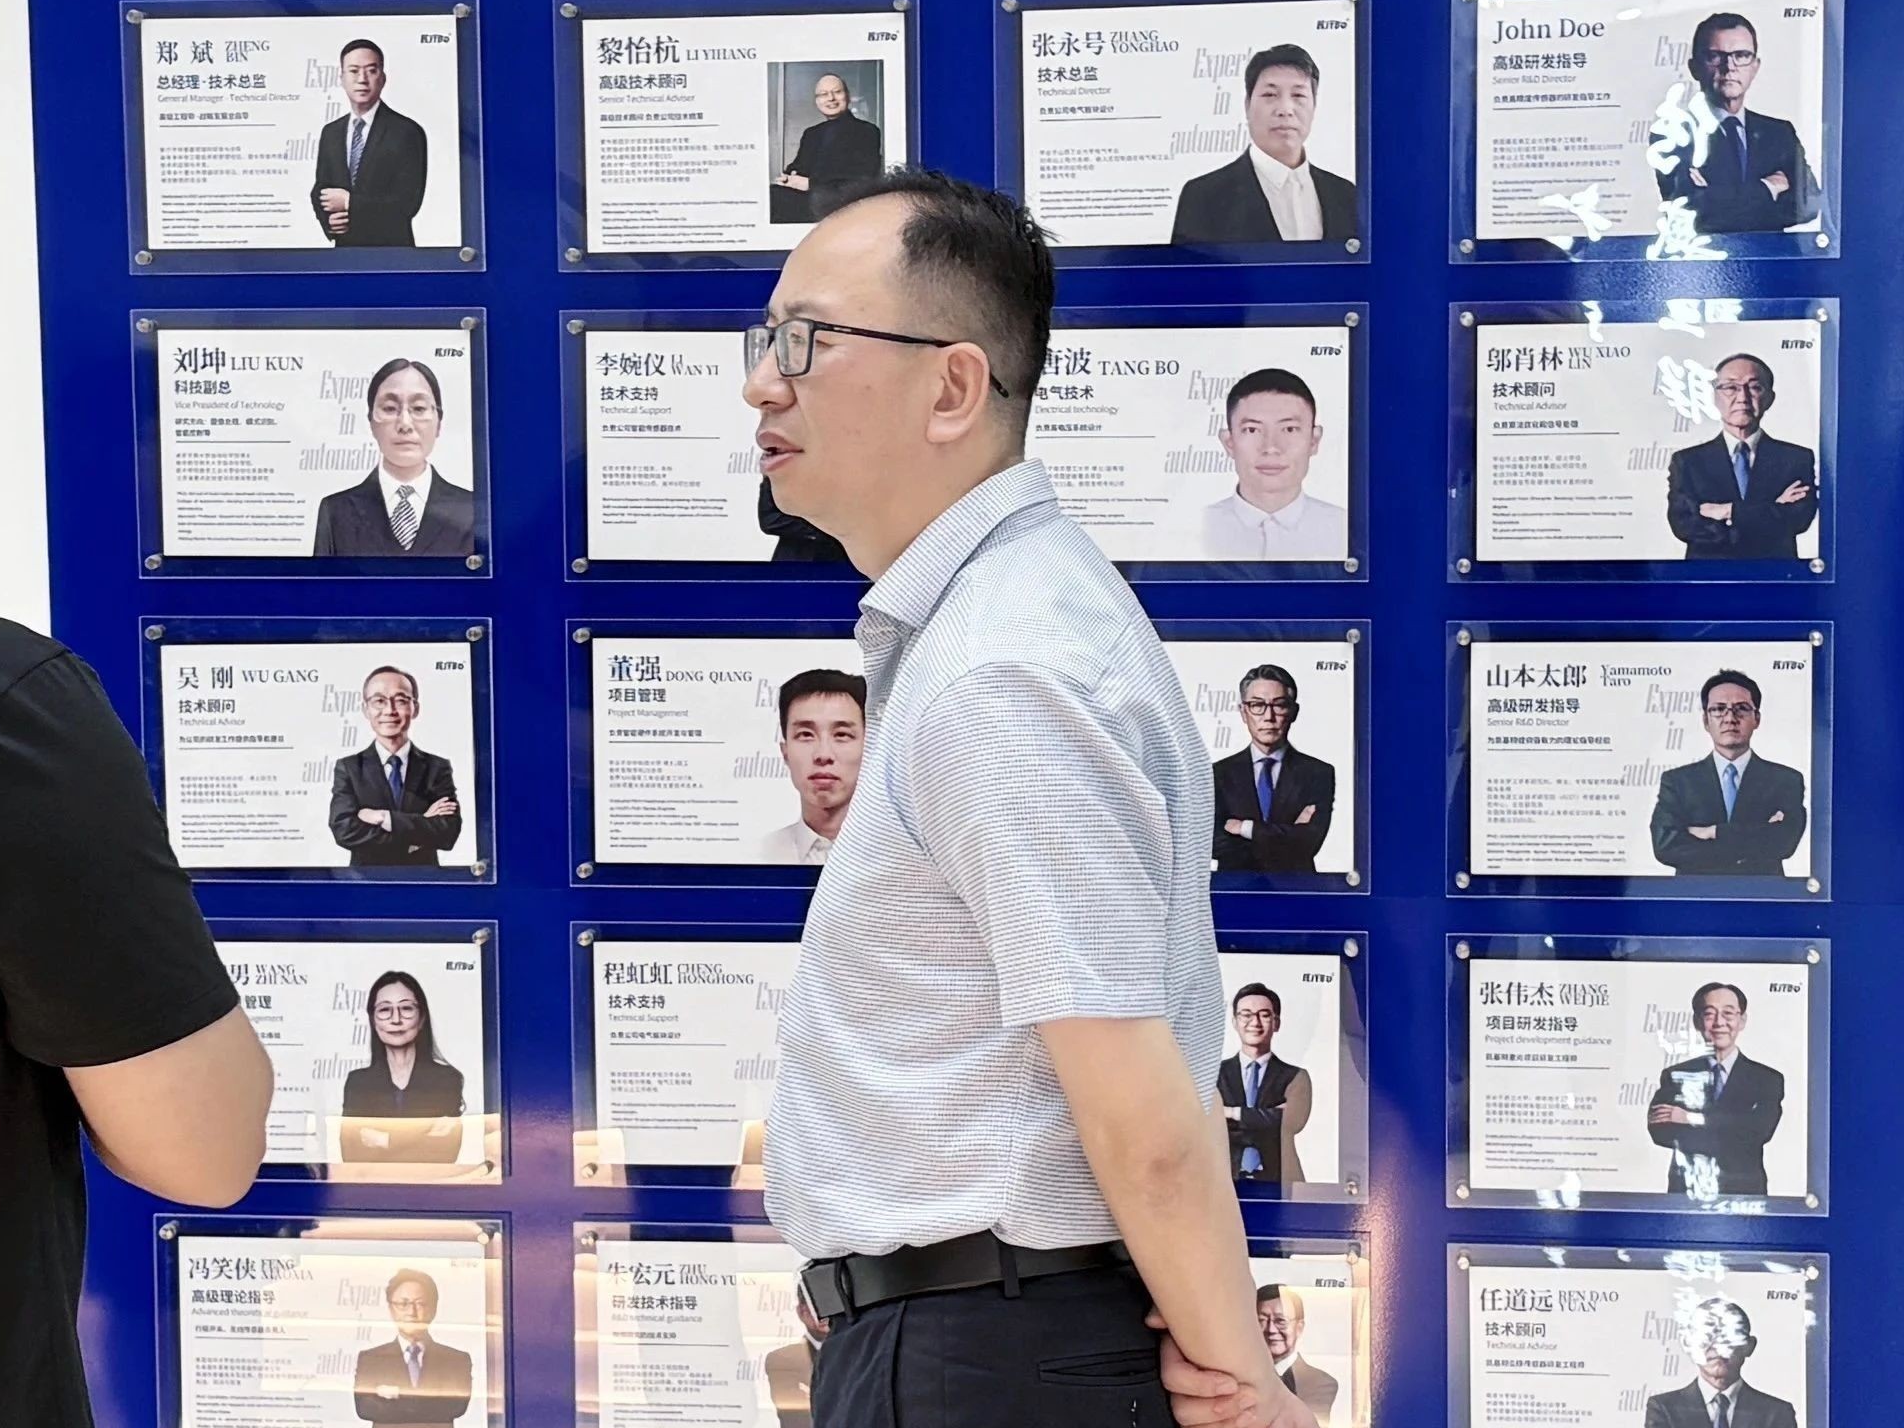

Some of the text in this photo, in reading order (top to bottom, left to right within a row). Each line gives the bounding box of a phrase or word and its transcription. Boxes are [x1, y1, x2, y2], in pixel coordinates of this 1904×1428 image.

[1111, 30, 1158, 42] ZHANG
[1493, 18, 1605, 44] John Doe
[597, 35, 680, 65] 黎怡杭
[1032, 32, 1105, 57] 张永号
[1111, 41, 1179, 53] YONGHAO
[686, 48, 757, 61] LI YIHANG
[1493, 53, 1587, 70] 高级研发指导
[599, 74, 687, 90] 高级技术顾问
[1038, 67, 1099, 82] 技术总监
[174, 347, 226, 374] 刘坤
[231, 357, 303, 371] LIU KUN
[596, 353, 666, 376] 李婉仪
[1487, 347, 1563, 372] 邬肖林
[1098, 360, 1179, 375] TANG BO
[175, 381, 231, 395] 科技副总
[601, 386, 658, 401] 技术支持
[1035, 386, 1094, 400] 电气技术
[1493, 382, 1555, 398] 技术顾问
[242, 669, 319, 683] WU GANG
[608, 655, 662, 682] 董强
[1487, 664, 1587, 688] 山本太郎
[1601, 664, 1671, 676] Yamamoto
[178, 666, 233, 689] 吴刚
[666, 671, 752, 683] DONG QIANG
[1601, 675, 1631, 687] Taro
[608, 688, 666, 702] 项目管理
[179, 699, 236, 713] 技术顾问
[1487, 698, 1580, 713] 高级研发指导
[604, 962, 673, 984] 程虹虹
[1480, 981, 1554, 1006] 张伟杰
[608, 994, 666, 1009] 技术支持
[1486, 1016, 1578, 1032] 项目研发指导
[189, 1257, 256, 1280] 冯笑侠
[192, 1290, 276, 1304] 高级理论指导
[612, 1295, 697, 1310] 研发技术指导
[1480, 1288, 1552, 1312] 任道远
[1486, 1322, 1546, 1338] 技术顾问
